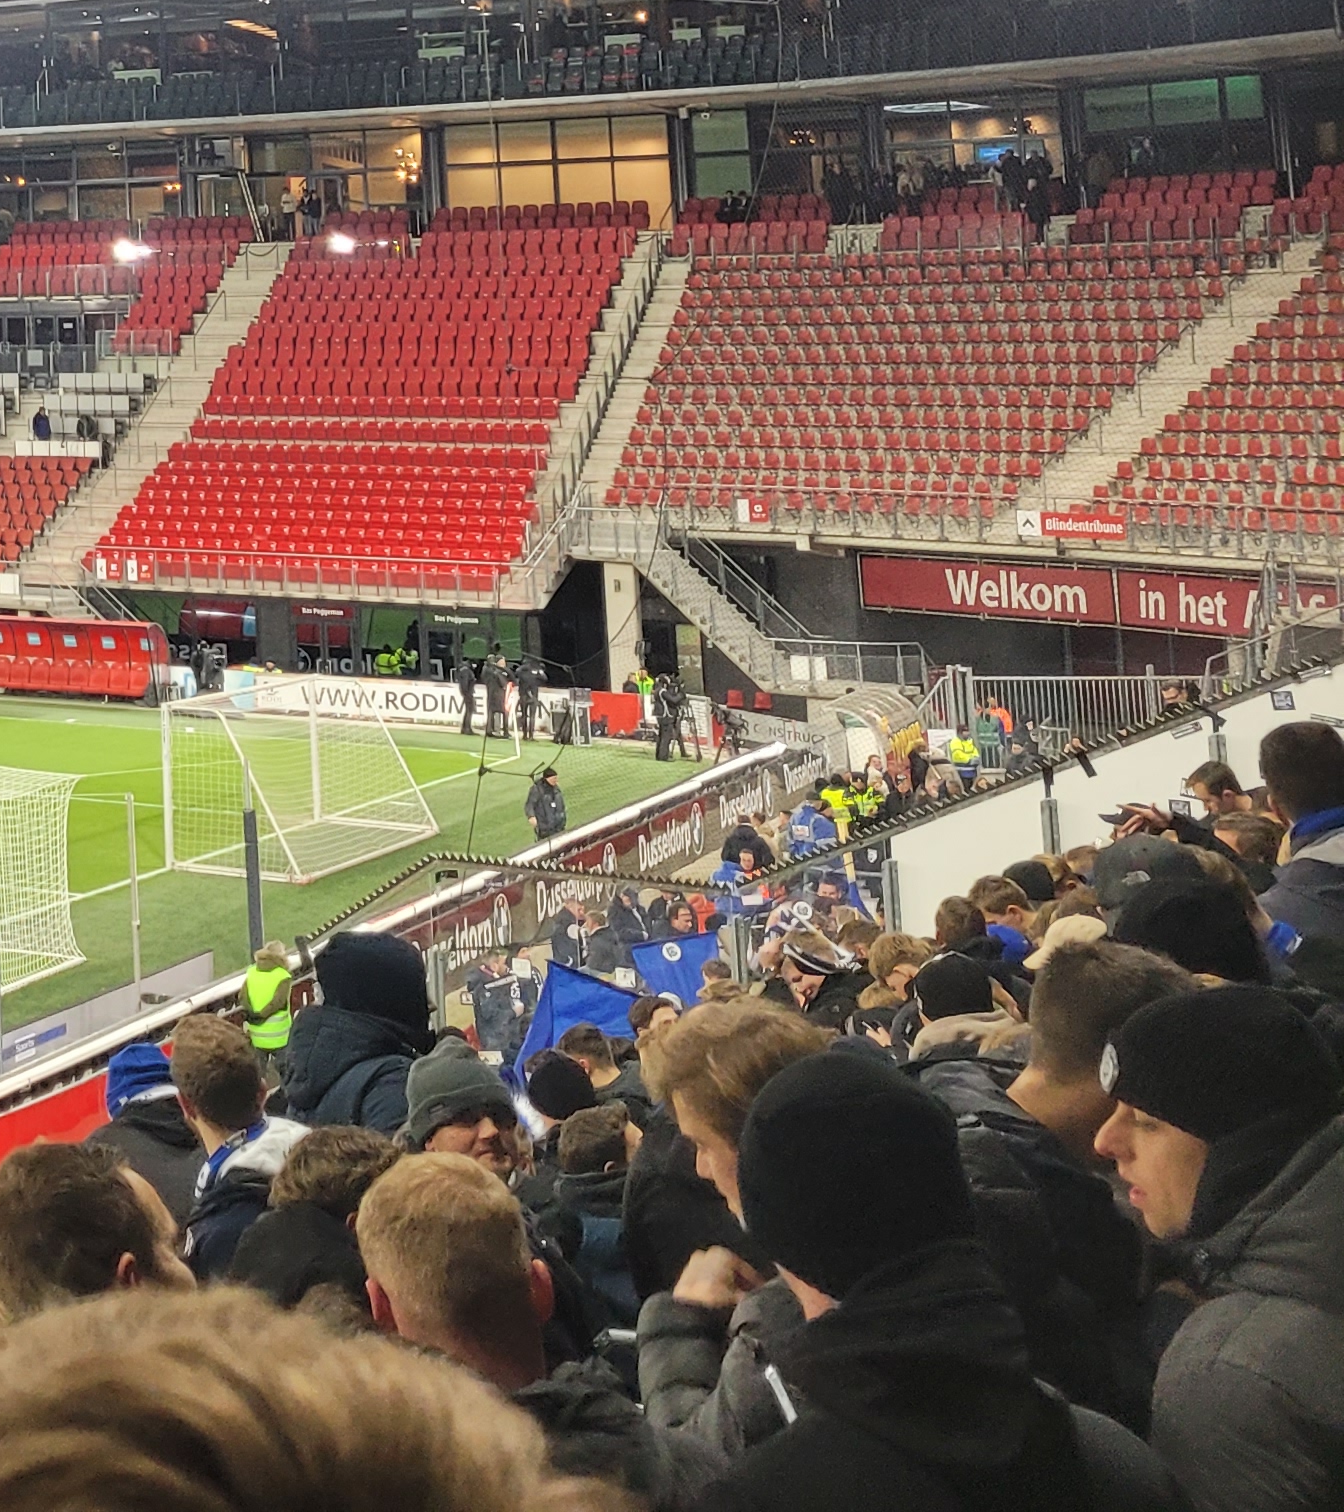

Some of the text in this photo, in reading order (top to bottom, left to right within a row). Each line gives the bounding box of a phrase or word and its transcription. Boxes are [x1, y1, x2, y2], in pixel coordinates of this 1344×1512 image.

[1044, 517, 1124, 534] Blindentribune
[944, 567, 1088, 615] Welkom
[1138, 578, 1166, 621] in
[1178, 581, 1228, 628] het
[637, 818, 692, 872] Dusseldorp
